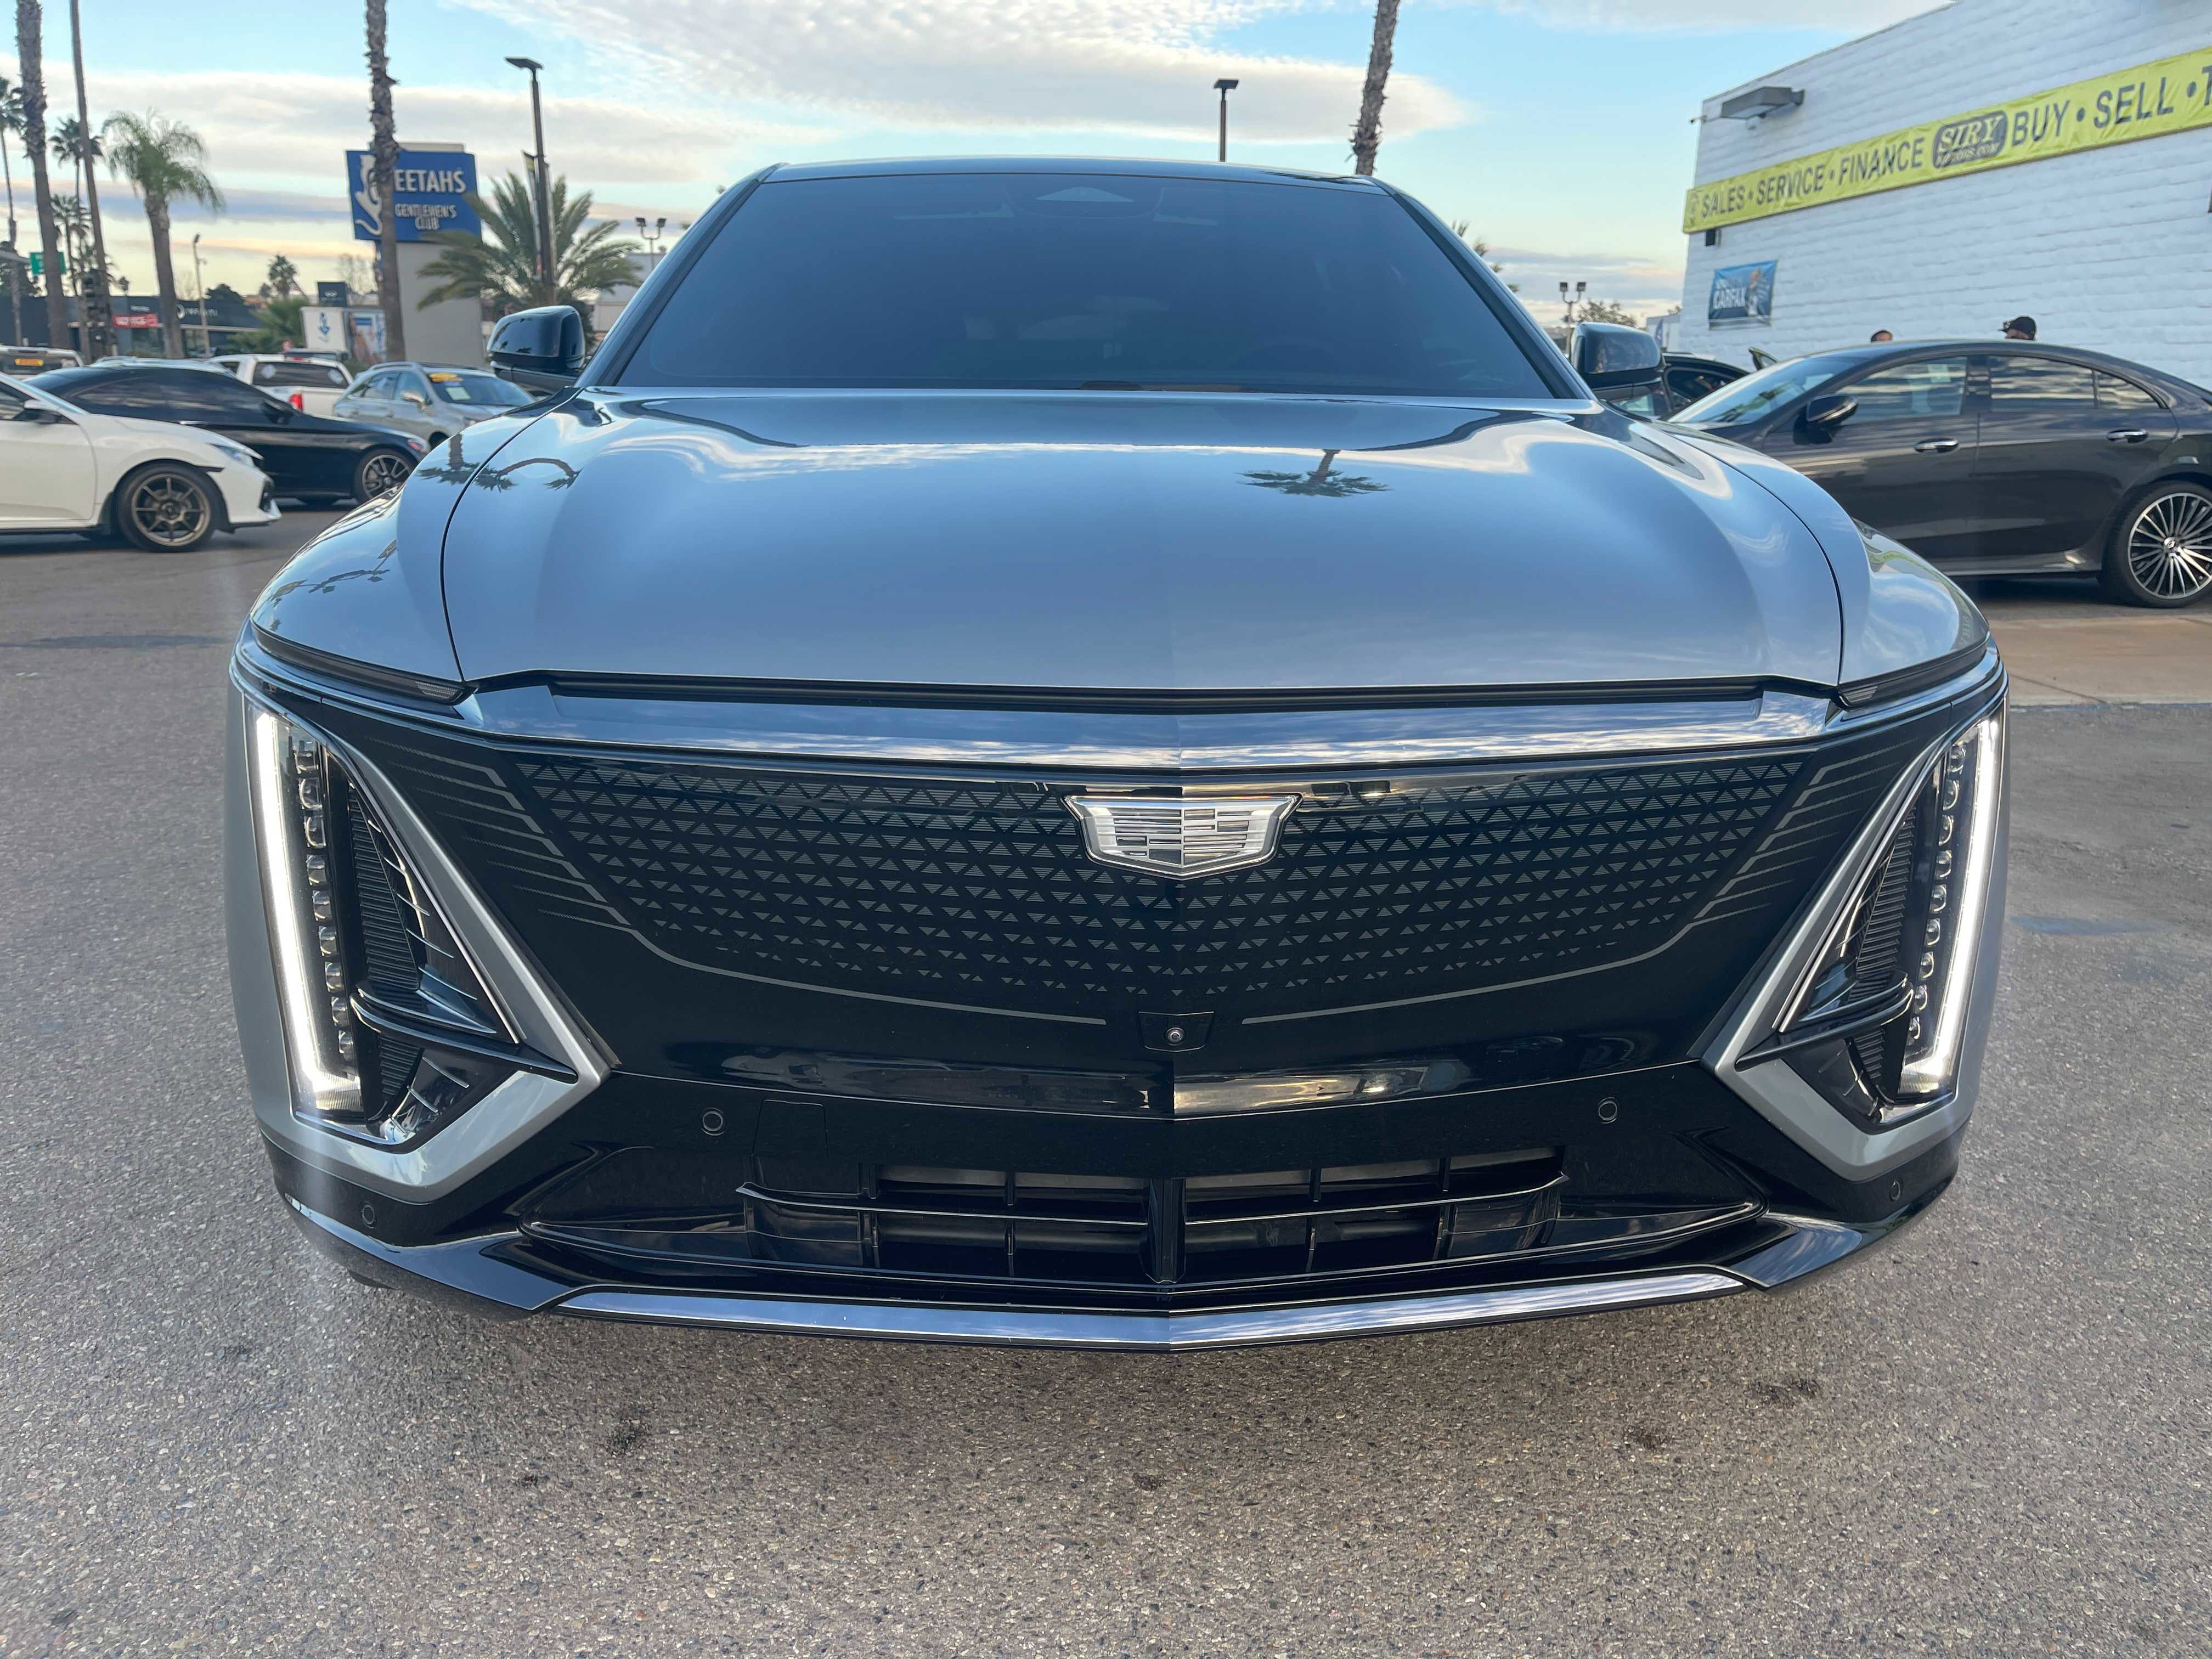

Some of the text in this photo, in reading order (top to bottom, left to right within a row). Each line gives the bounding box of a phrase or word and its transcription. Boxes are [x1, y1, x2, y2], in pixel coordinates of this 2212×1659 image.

[2012, 100, 2070, 146] BUY
[2094, 77, 2174, 128] SELL
[1937, 115, 2004, 153] SIRY
[375, 169, 466, 195] EETAHS
[1702, 137, 1926, 218] SALES SERVICE FINANCE
[1713, 287, 1747, 309] CARFAX
